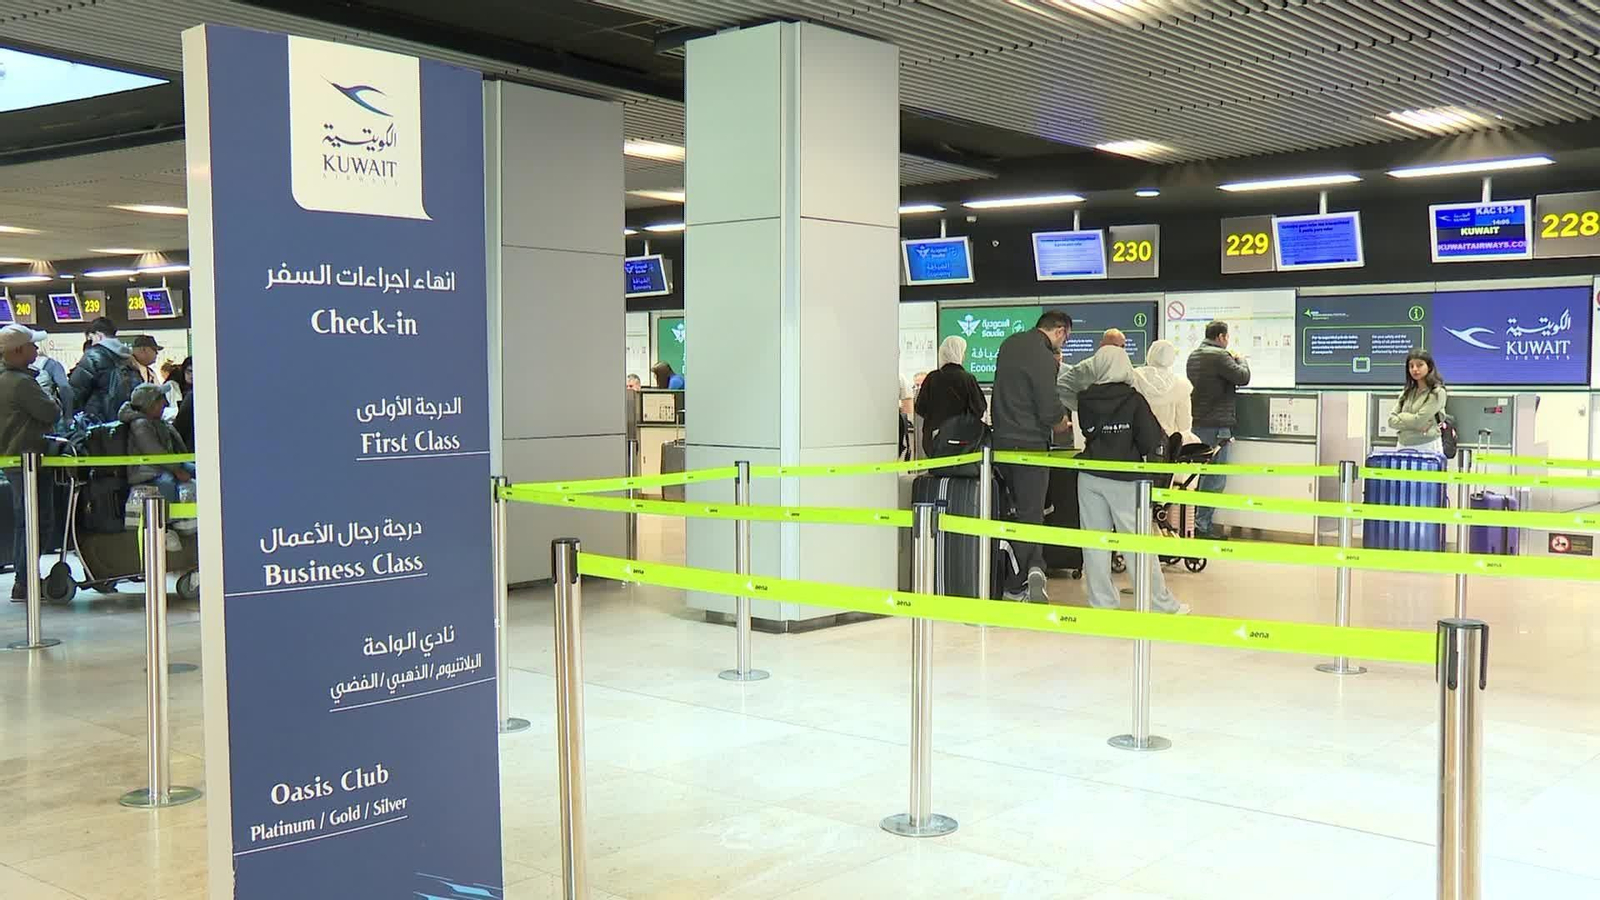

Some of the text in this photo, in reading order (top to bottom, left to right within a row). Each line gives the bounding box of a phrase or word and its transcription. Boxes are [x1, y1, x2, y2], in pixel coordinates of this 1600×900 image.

[322, 122, 397, 152] الكويتية
[322, 153, 398, 178] KUWAIT
[1476, 205, 1515, 215] KAC 134
[1461, 226, 1500, 236] KUWAIT
[1541, 211, 1600, 238] 228
[1113, 240, 1152, 262] 230
[1226, 232, 1269, 256] 229
[265, 262, 456, 293] انهاء اجراءات السفر
[16, 303, 31, 316] 240
[84, 300, 100, 313] 239
[128, 296, 143, 310] 238
[311, 308, 418, 335] Check-in
[1506, 308, 1571, 337] الكويتية
[1505, 340, 1571, 355] KUWAIT
[970, 362, 997, 372] Econo
[356, 396, 462, 422] الدرجة الأولى
[360, 430, 460, 454] First Class
[260, 518, 422, 553] درجة رجال الأعمال
[263, 553, 423, 586] Business Class
[1060, 615, 1077, 623] aena
[363, 625, 455, 657] نادي الواحة
[1249, 631, 1270, 640] aena
[270, 763, 389, 805] Oasis Club
[250, 797, 407, 842] Platinum / Gold / Silver
